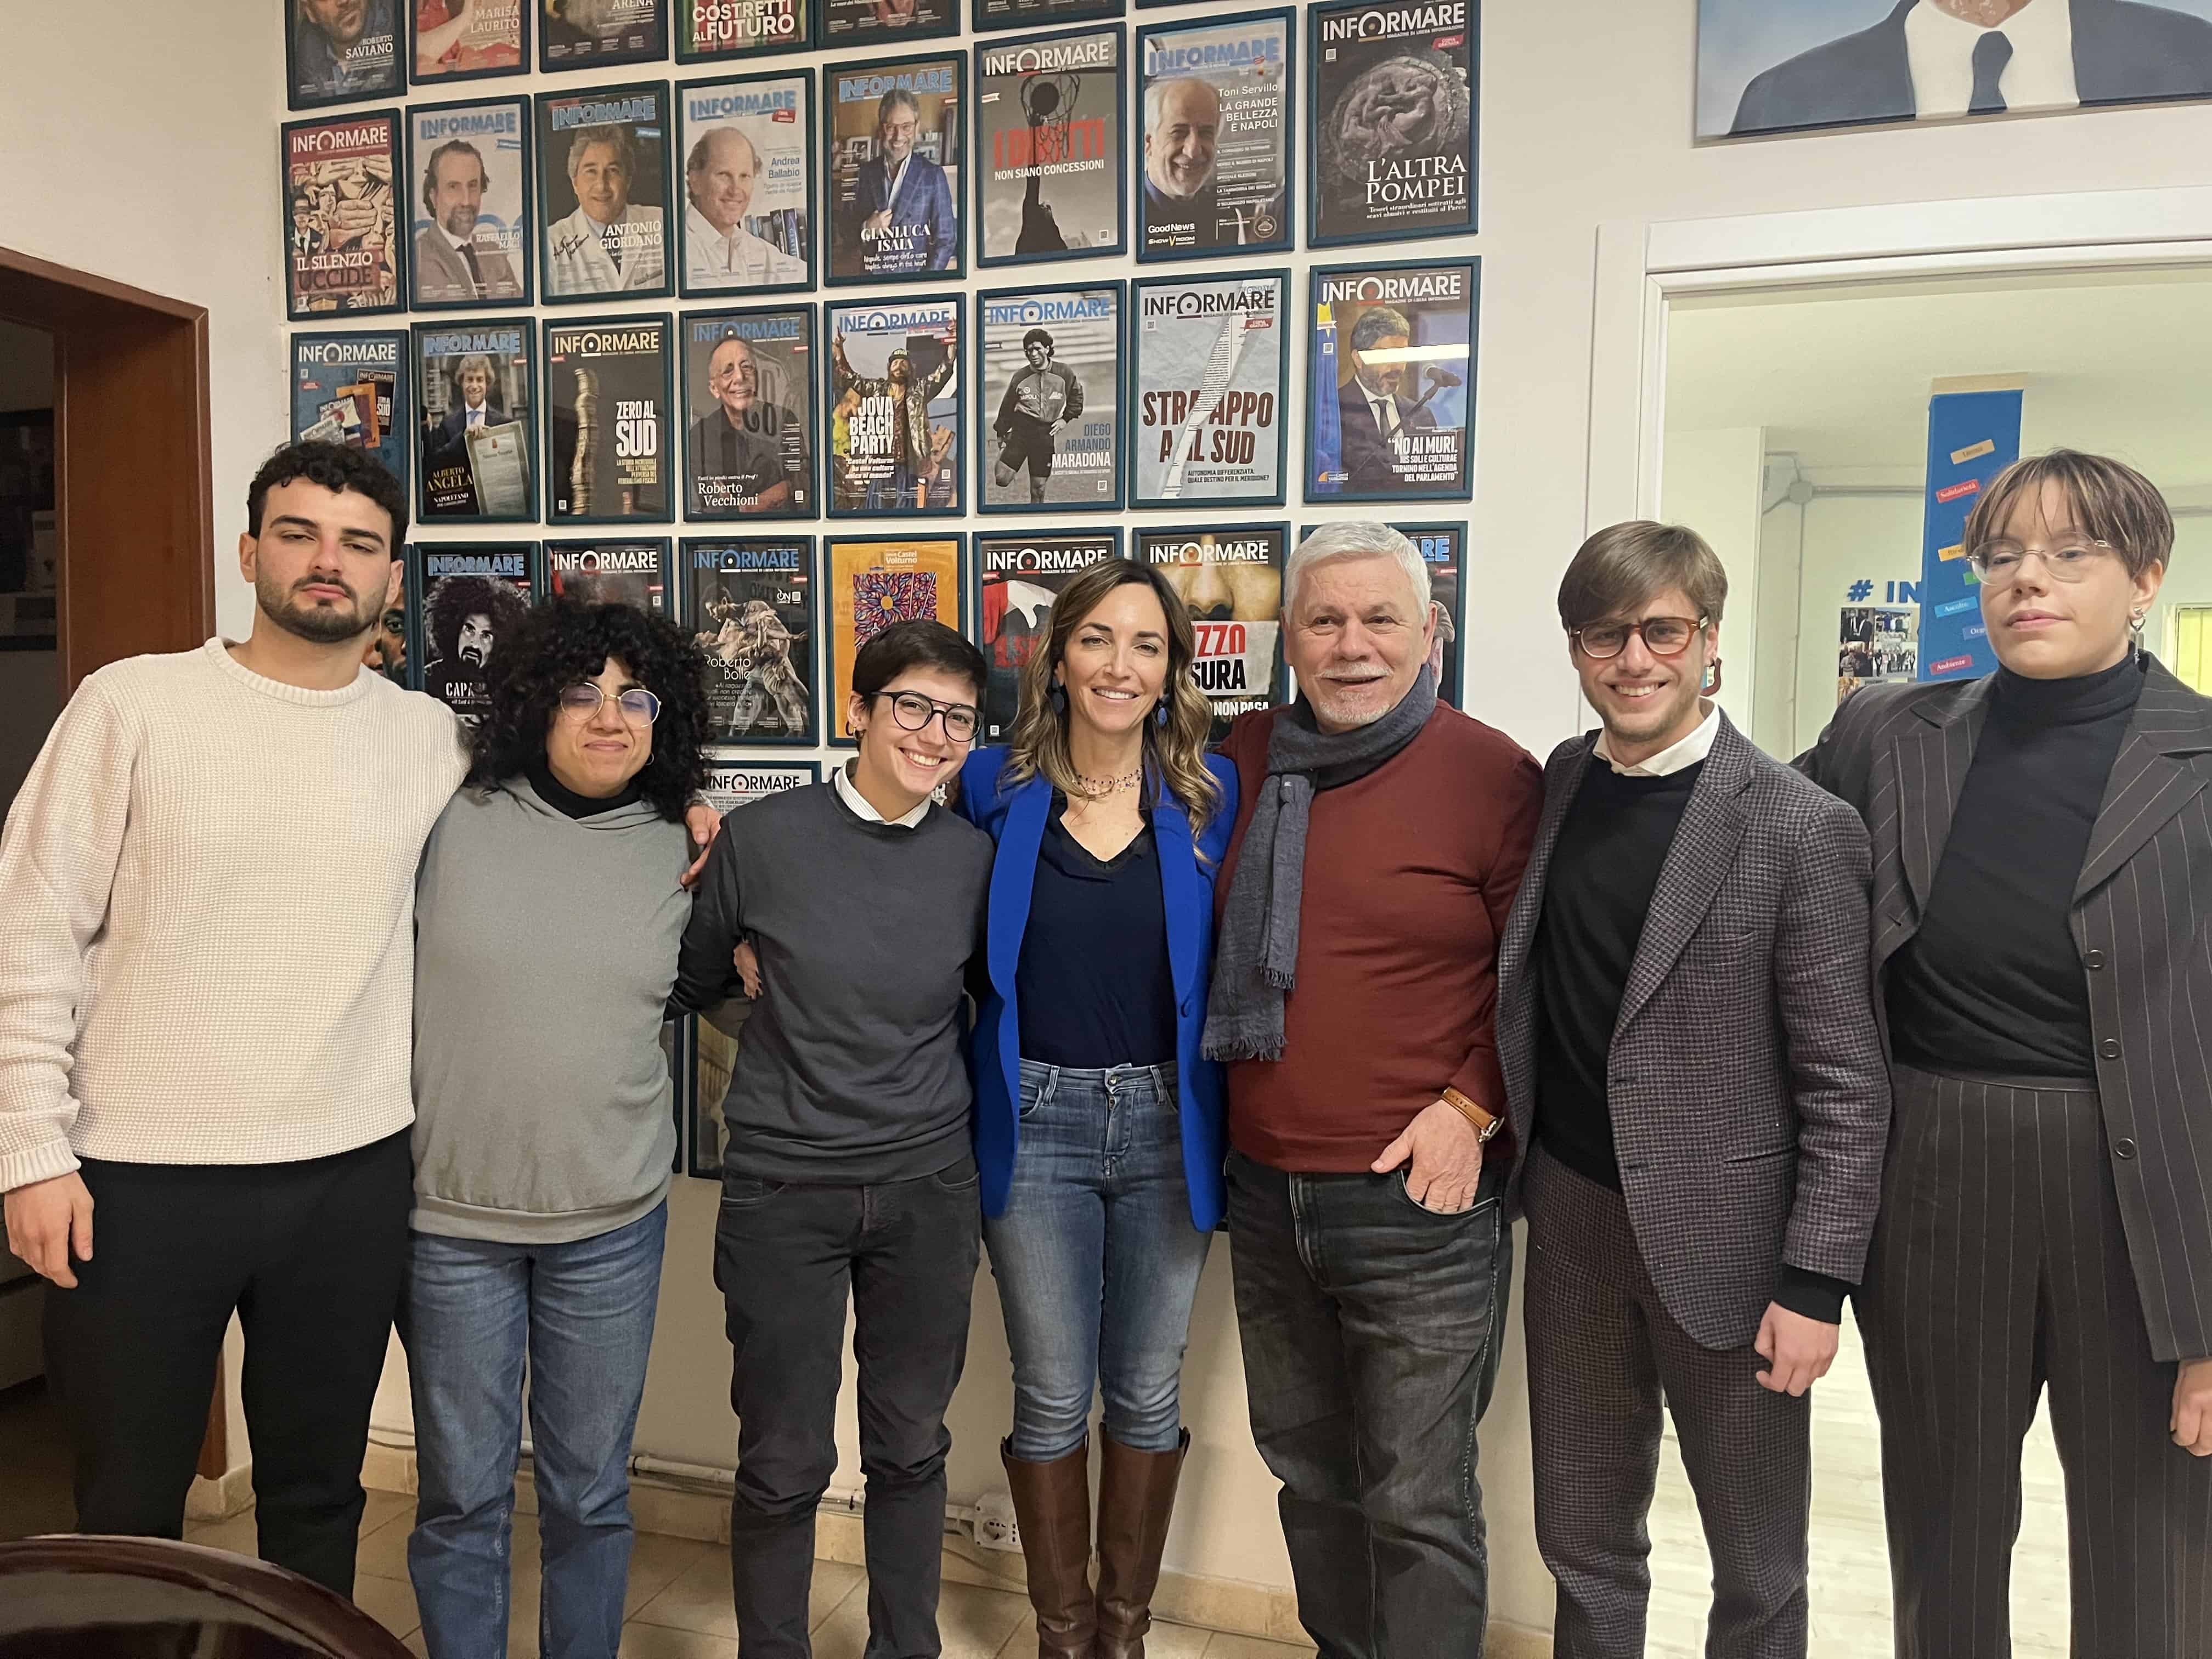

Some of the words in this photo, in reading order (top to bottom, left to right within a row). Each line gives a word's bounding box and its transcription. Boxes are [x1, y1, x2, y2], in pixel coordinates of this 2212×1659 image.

[476, 5, 520, 19] MARISA
[692, 0, 792, 22] COSTRETTI
[471, 18, 520, 33] LAURITO
[692, 32, 706, 42] AL
[707, 14, 795, 41] FUTURO
[1323, 2, 1465, 41] INFORMARE
[362, 35, 393, 45] ROBERTO
[346, 43, 393, 59] SAVIANO
[986, 41, 1109, 76] INFORMARE
[1149, 37, 1279, 76] INFORMARE
[839, 70, 952, 103] INFORMARE
[1218, 88, 1239, 98] Toni
[1242, 83, 1278, 95] Servillo
[690, 90, 796, 122] INFORMARE
[1220, 103, 1233, 112] LA
[1235, 97, 1278, 110] GRANDE
[552, 98, 655, 131] INFORMARE
[1226, 109, 1278, 122] BELLEZZA
[421, 112, 517, 140] INFORMARE
[1231, 123, 1238, 132] E
[1240, 120, 1278, 131] NAPOLI
[293, 126, 387, 153] INFORMARE
[771, 157, 800, 166] Andrea
[995, 170, 1014, 180] NON
[1015, 167, 1042, 178] SIANO
[1043, 159, 1104, 175] CONCESSIONI
[768, 168, 800, 179] Ballabio
[1365, 176, 1465, 204] POMPEI
[476, 232, 521, 242] RAFFAELLO
[606, 221, 662, 237] ANTONIO
[861, 224, 930, 241] GIANLUCA
[600, 234, 662, 250] GIORDANO
[878, 238, 914, 252] ISAIA
[297, 257, 308, 271] IL
[312, 252, 373, 269] SILENZIO
[298, 268, 373, 290] UCCIDE
[1323, 274, 1460, 301] INFORMARE
[990, 298, 1110, 323] INFORMARE
[1144, 290, 1274, 315] INFORMARE
[693, 319, 799, 342] INFORMARE
[839, 311, 950, 332] INFORMARE
[424, 332, 520, 357] INFORMARE
[555, 332, 658, 354] INFORMARE
[298, 343, 396, 362] INFORMARE
[616, 402, 642, 420] ZERO
[643, 400, 656, 419] AL
[858, 396, 894, 416] JOVA
[849, 416, 894, 436] BEACH
[1084, 423, 1111, 436] DIEGO
[616, 420, 657, 457] SUD
[850, 434, 894, 455] PARTY
[1065, 438, 1110, 452] ARMANDO
[1211, 430, 1255, 464] SUD
[1412, 437, 1424, 454] AI
[1426, 436, 1458, 454] MURI.
[1052, 452, 1111, 468] MARADONA
[1410, 455, 1423, 464] SOLI
[433, 466, 465, 478] ALBERTO
[1392, 465, 1418, 473] TORNINO
[1404, 473, 1415, 482] DEL
[426, 474, 473, 492] ANGELA
[698, 482, 743, 494] Roberto
[433, 493, 469, 503] NAPOLETANO
[703, 493, 759, 506] Vecchioni
[554, 550, 657, 571] INFORMARE
[693, 549, 799, 568] INFORMARE
[885, 556, 918, 565] Volturno
[1150, 542, 1268, 563] INFORMARE
[428, 556, 524, 576] INFORMARE
[704, 651, 751, 667] Roberto
[1937, 658, 1966, 671] Ambiente
[724, 666, 751, 680] Bolle
[1214, 702, 1238, 716] NON
